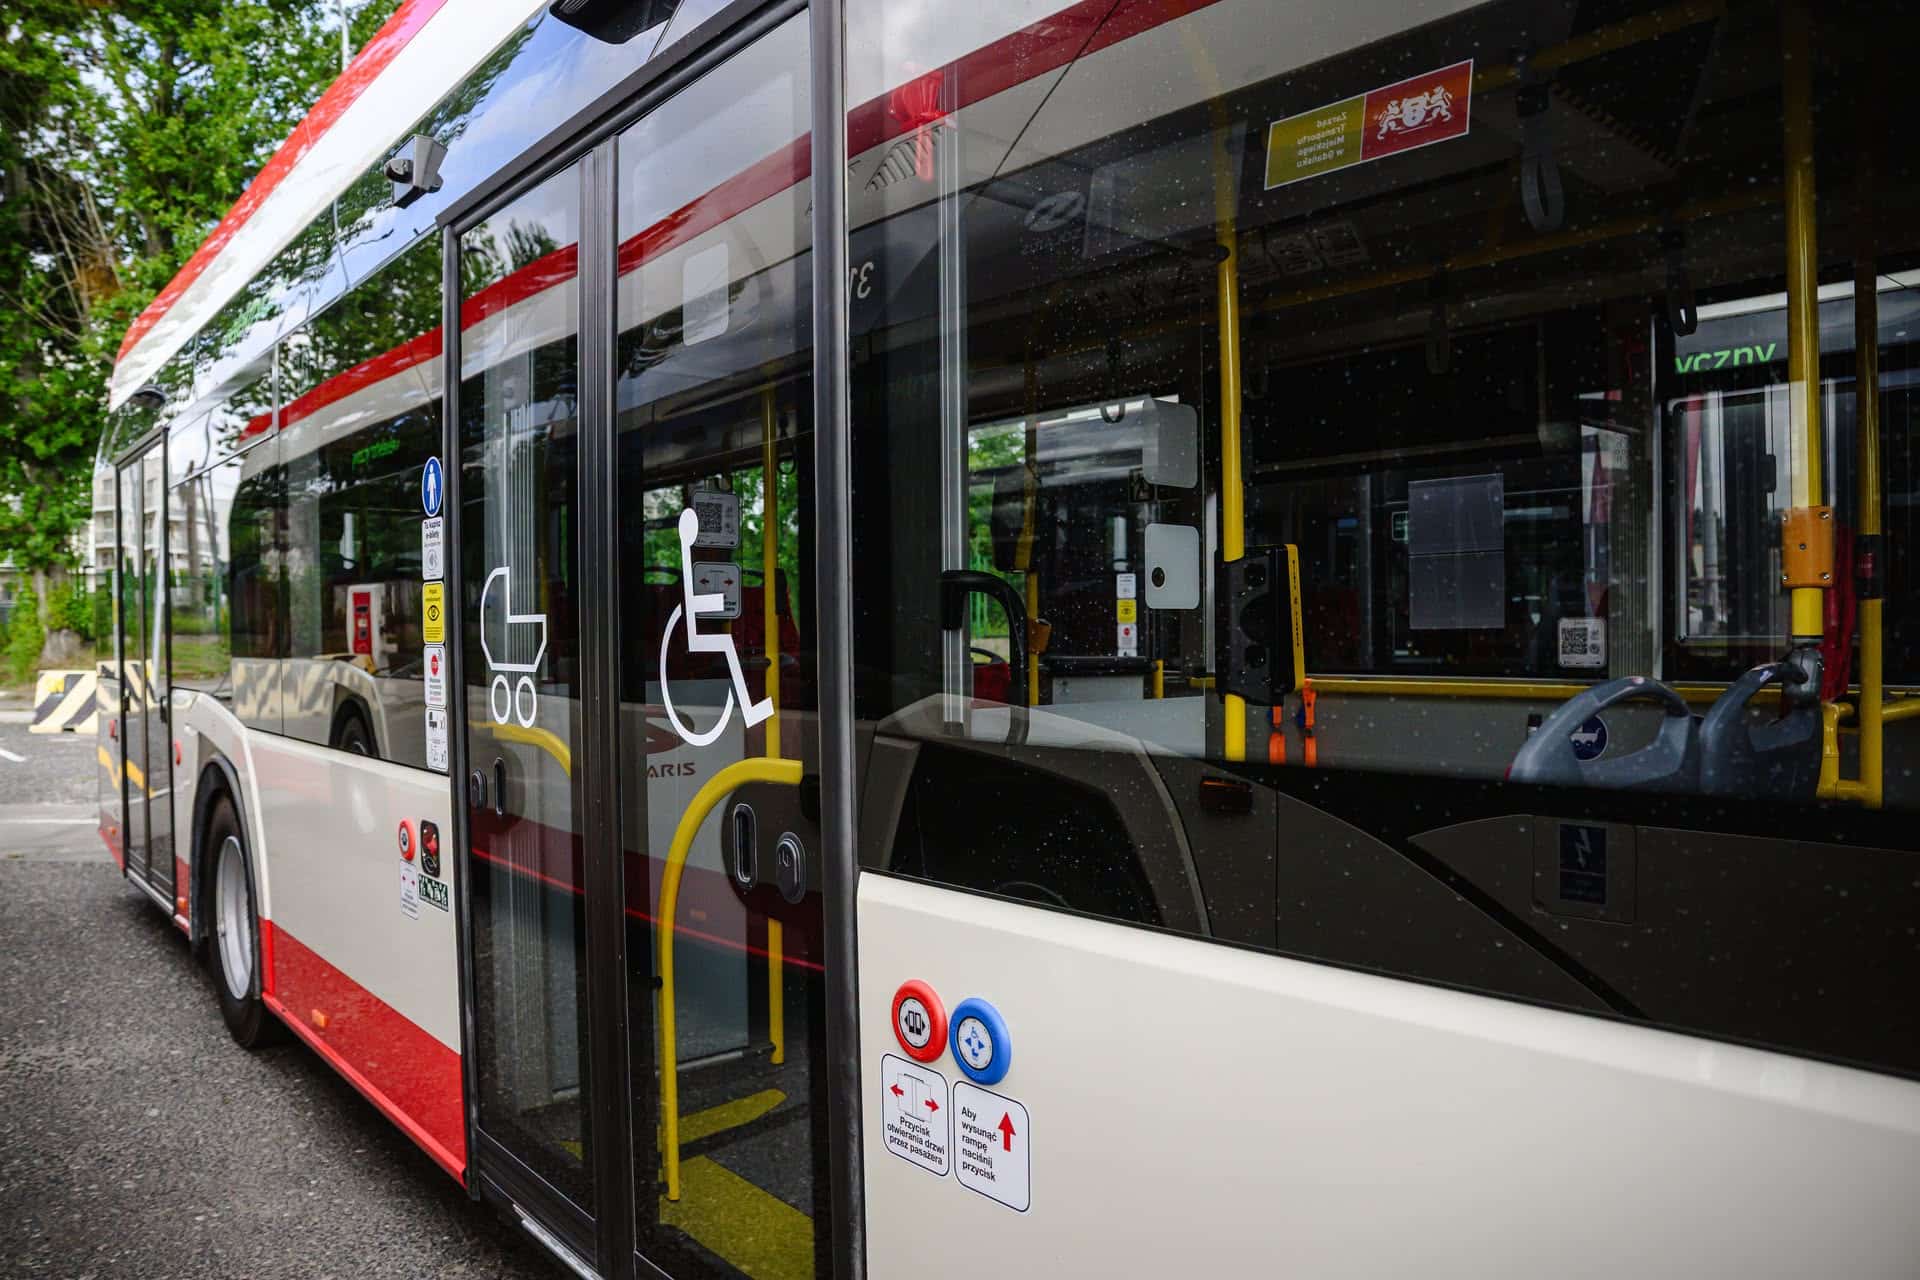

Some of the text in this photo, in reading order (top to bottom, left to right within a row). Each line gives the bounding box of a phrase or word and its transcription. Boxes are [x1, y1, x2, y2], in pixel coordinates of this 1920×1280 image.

[961, 1106, 977, 1122] Aby
[899, 1115, 931, 1138] Przycisk
[961, 1121, 998, 1142] wysunąć
[887, 1122, 945, 1155] otwierania drzwi
[961, 1135, 988, 1153] rampę
[889, 1135, 943, 1166] przez pasażera
[962, 1147, 993, 1169] naciśnij
[962, 1160, 996, 1182] przycisk
